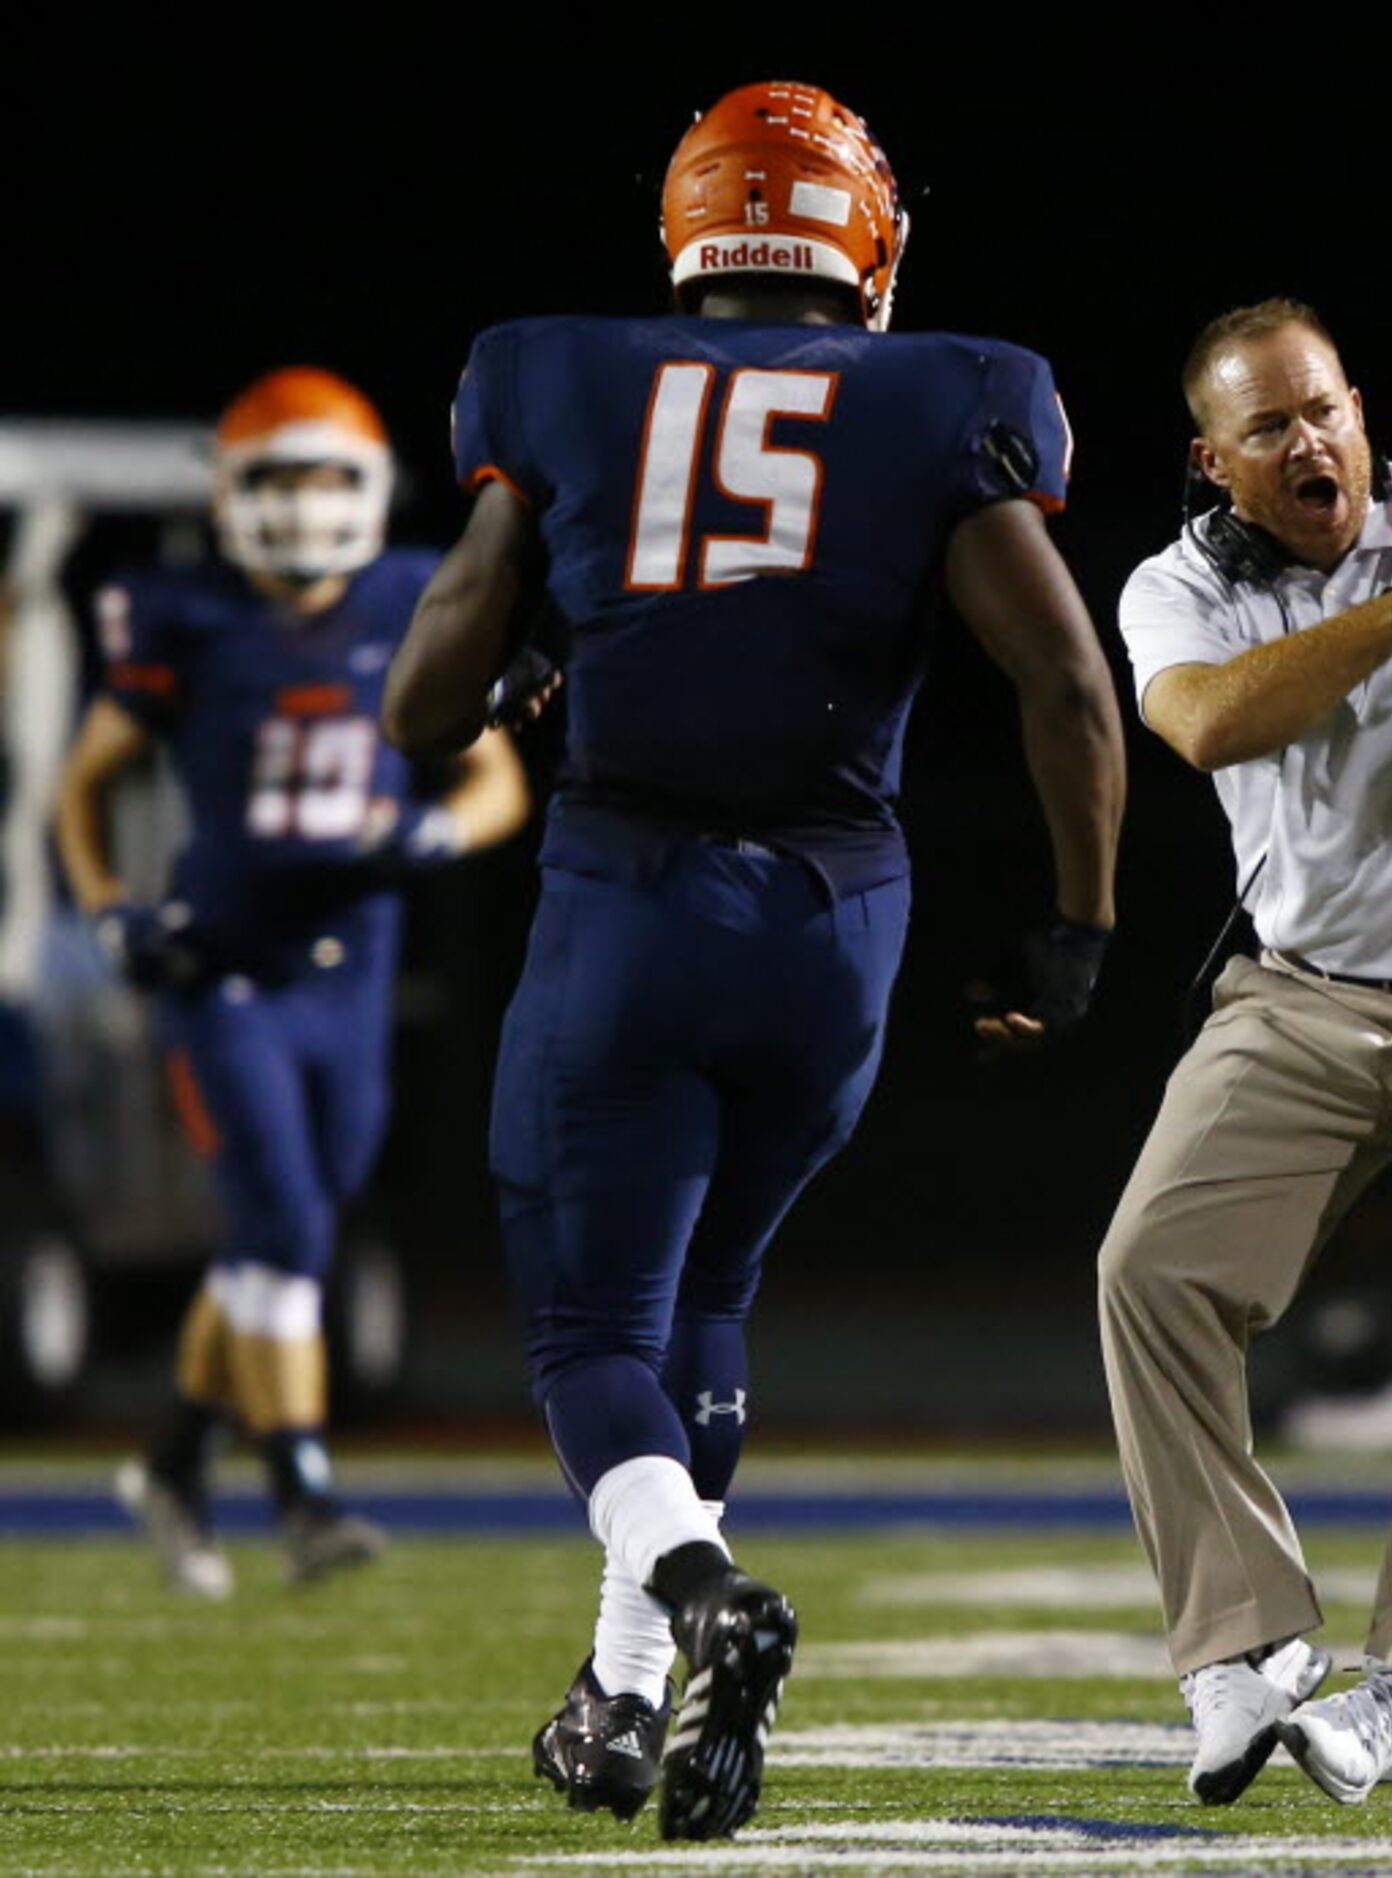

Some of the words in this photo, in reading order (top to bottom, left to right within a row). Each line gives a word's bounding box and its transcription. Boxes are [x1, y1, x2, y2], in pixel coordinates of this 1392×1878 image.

[745, 201, 769, 227] 15
[700, 243, 814, 269] Riddell
[623, 359, 840, 591] 15
